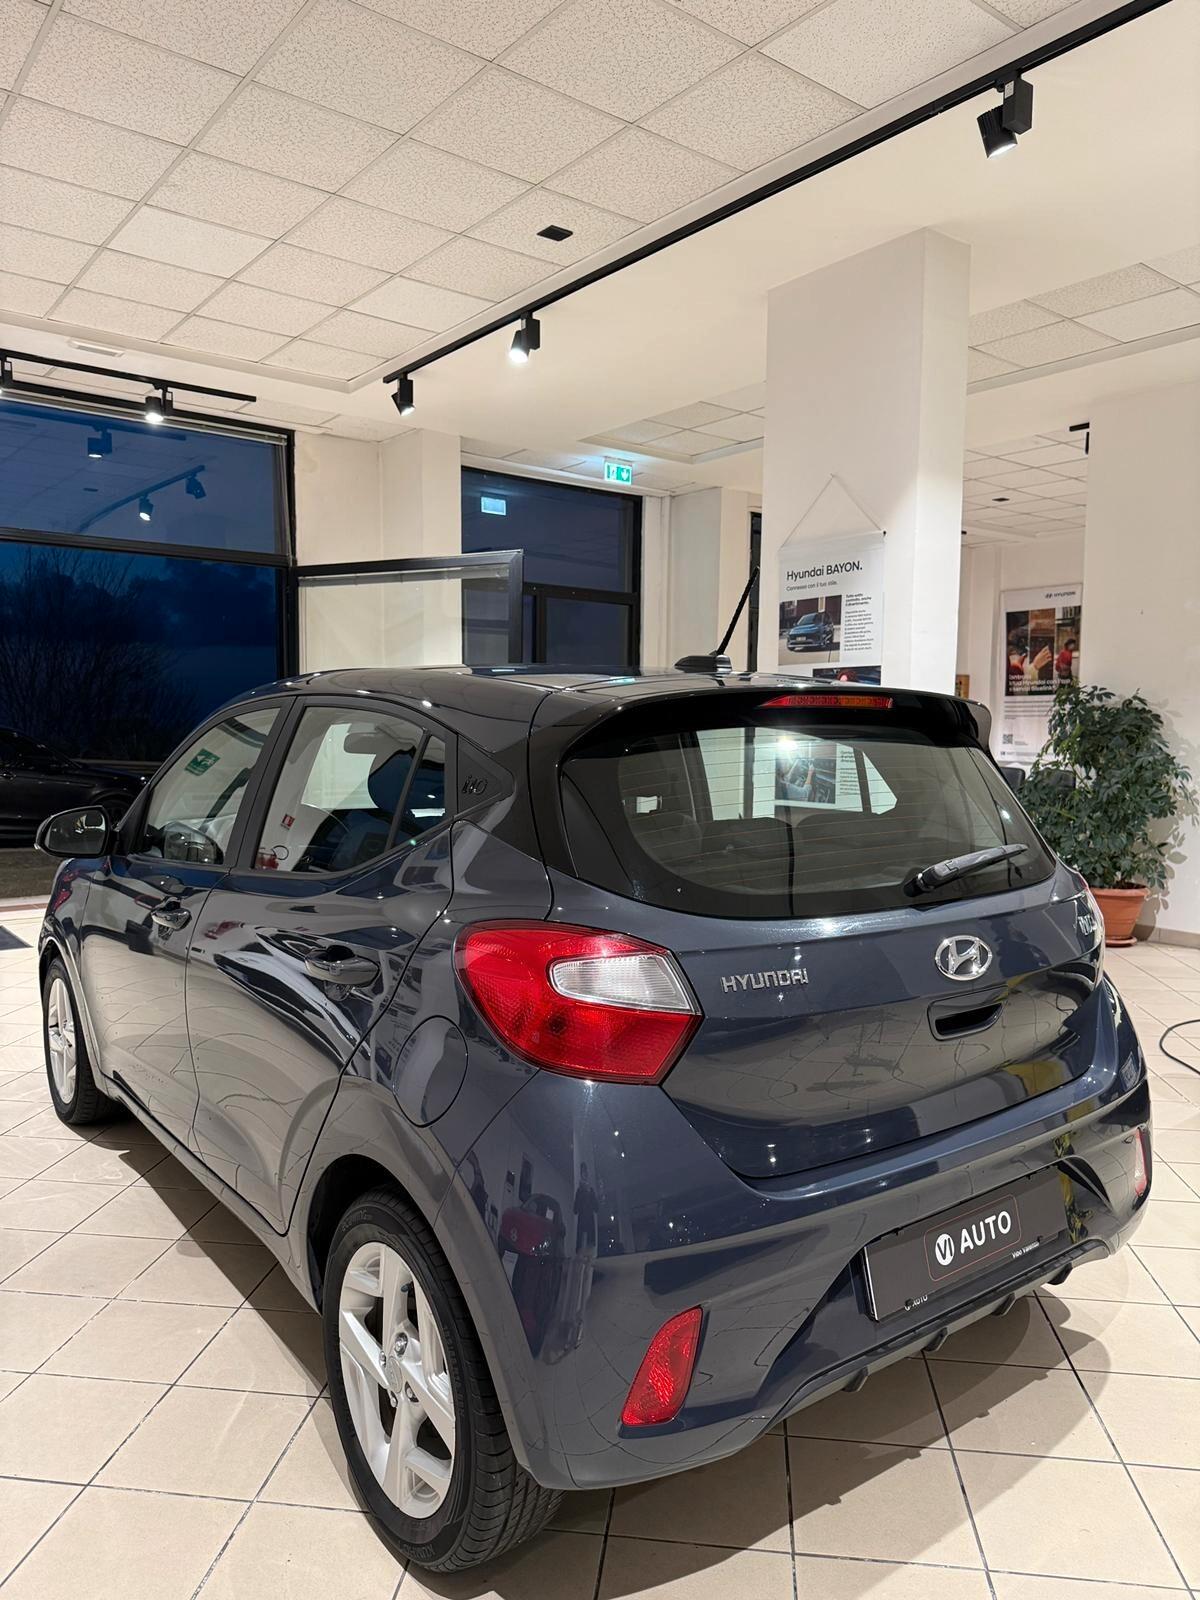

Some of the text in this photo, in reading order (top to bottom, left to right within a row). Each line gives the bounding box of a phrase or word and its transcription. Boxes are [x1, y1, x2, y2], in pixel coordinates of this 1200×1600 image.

[786, 560, 863, 582] Hyundai BAYON.
[721, 967, 809, 993] HYUNDAI
[960, 1210, 1012, 1254] AUTO
